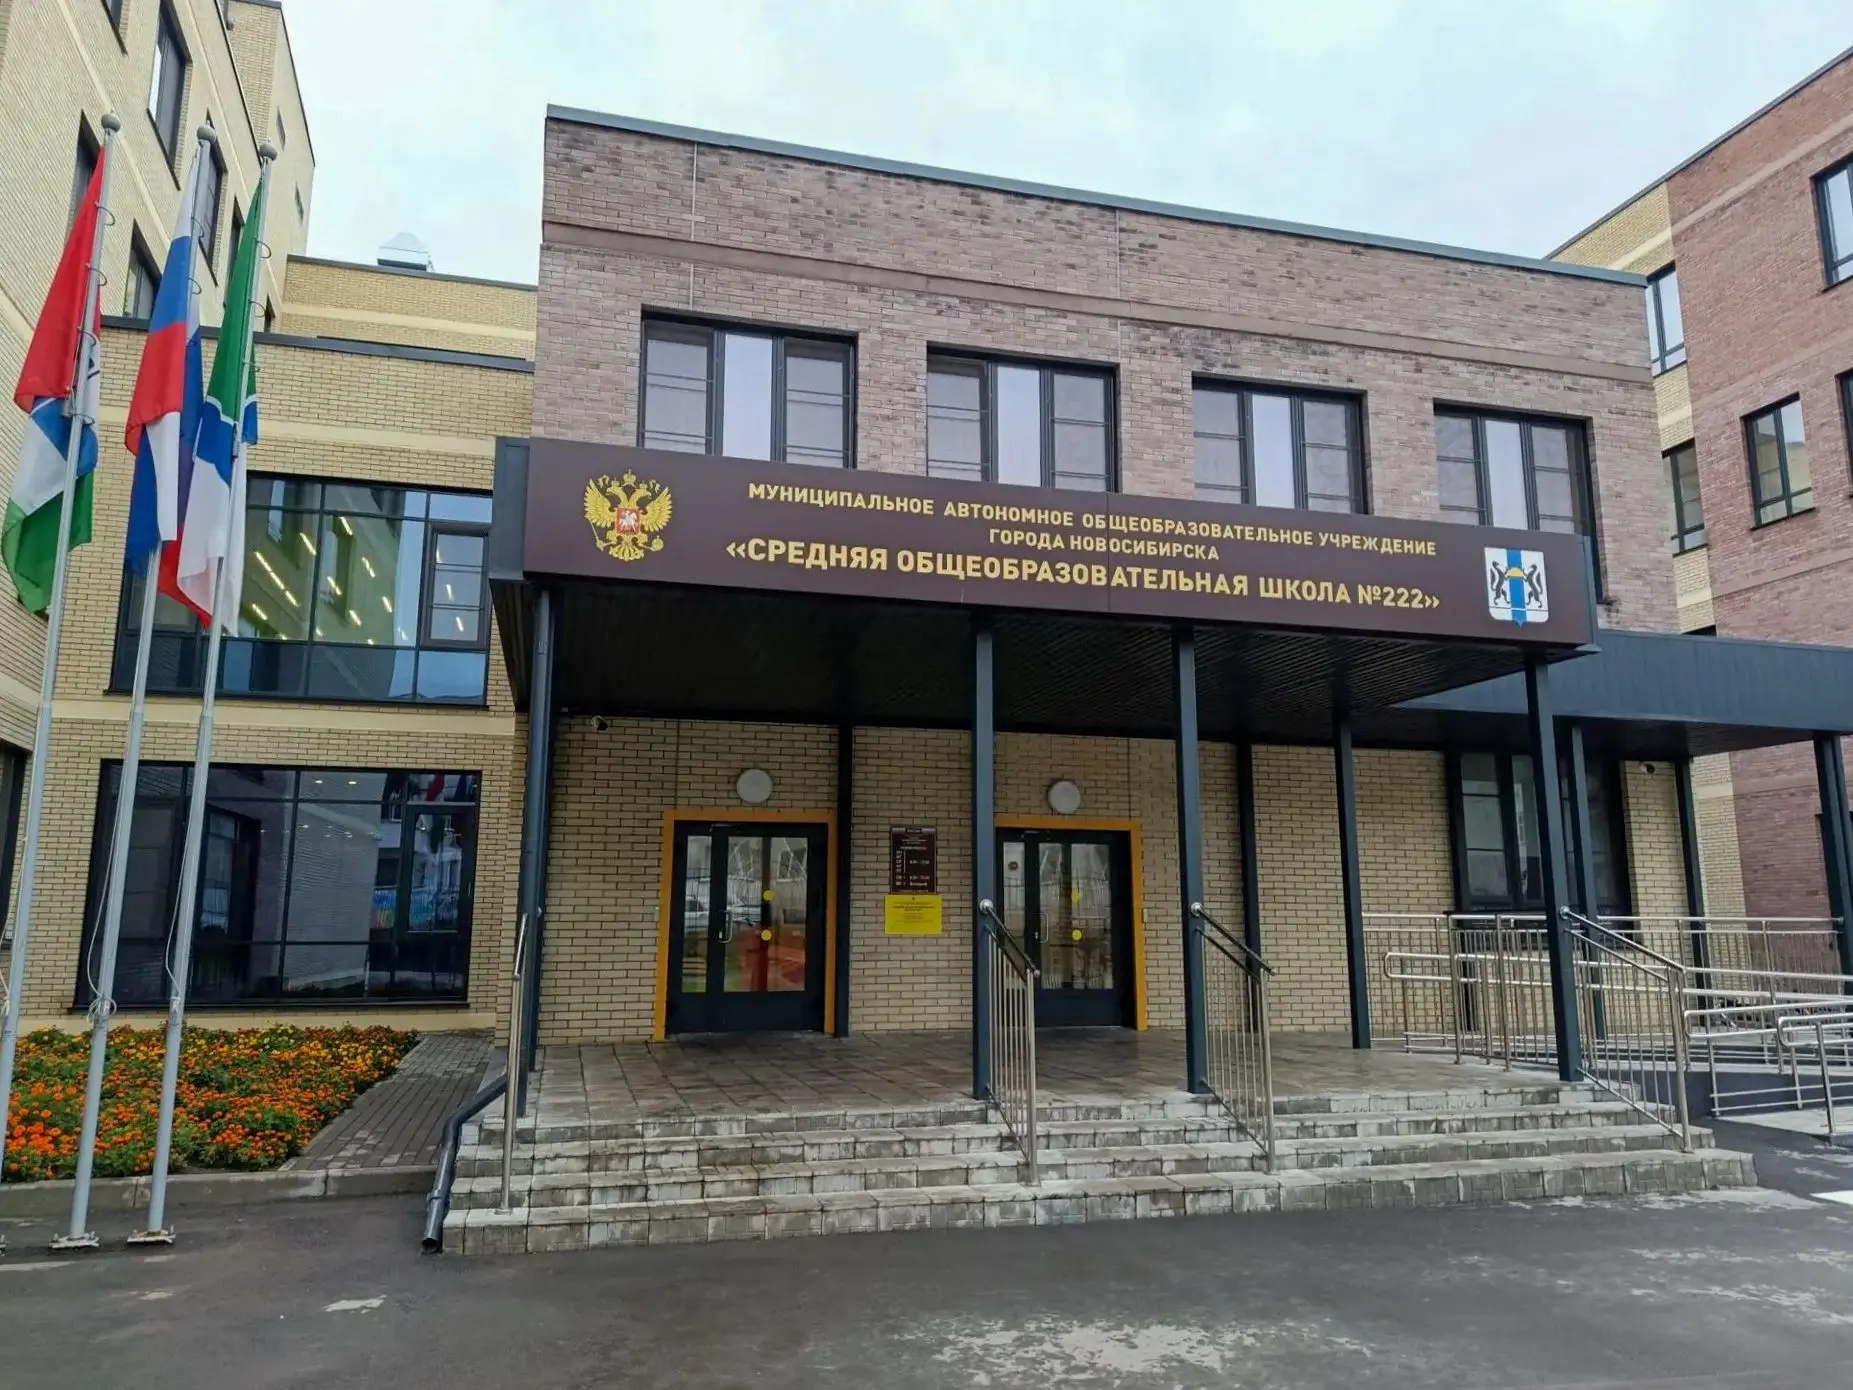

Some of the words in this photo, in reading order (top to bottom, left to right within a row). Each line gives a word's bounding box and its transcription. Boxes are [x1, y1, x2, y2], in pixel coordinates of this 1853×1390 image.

[748, 483, 934, 515] МУНИЦИПАЛЬНОЕ
[944, 502, 1074, 527] АВТОНОМНОЕ
[1082, 513, 1314, 546] ОБЩЕОБРАЗОВАТЕЛЬНОЕ
[1319, 533, 1436, 555] УЧРЕЖДЕНИЕ
[989, 528, 1066, 551] ГОРОДА
[1070, 535, 1219, 560] НОВОСИБИРСКА
[726, 537, 888, 571] «СРЕДНЯЯ
[897, 549, 1249, 596] ОБЩЕОБРАЗОВАТЕЛЬНАЯ
[1259, 578, 1351, 604] ШКОЛА
[1357, 584, 1440, 609] №222»
